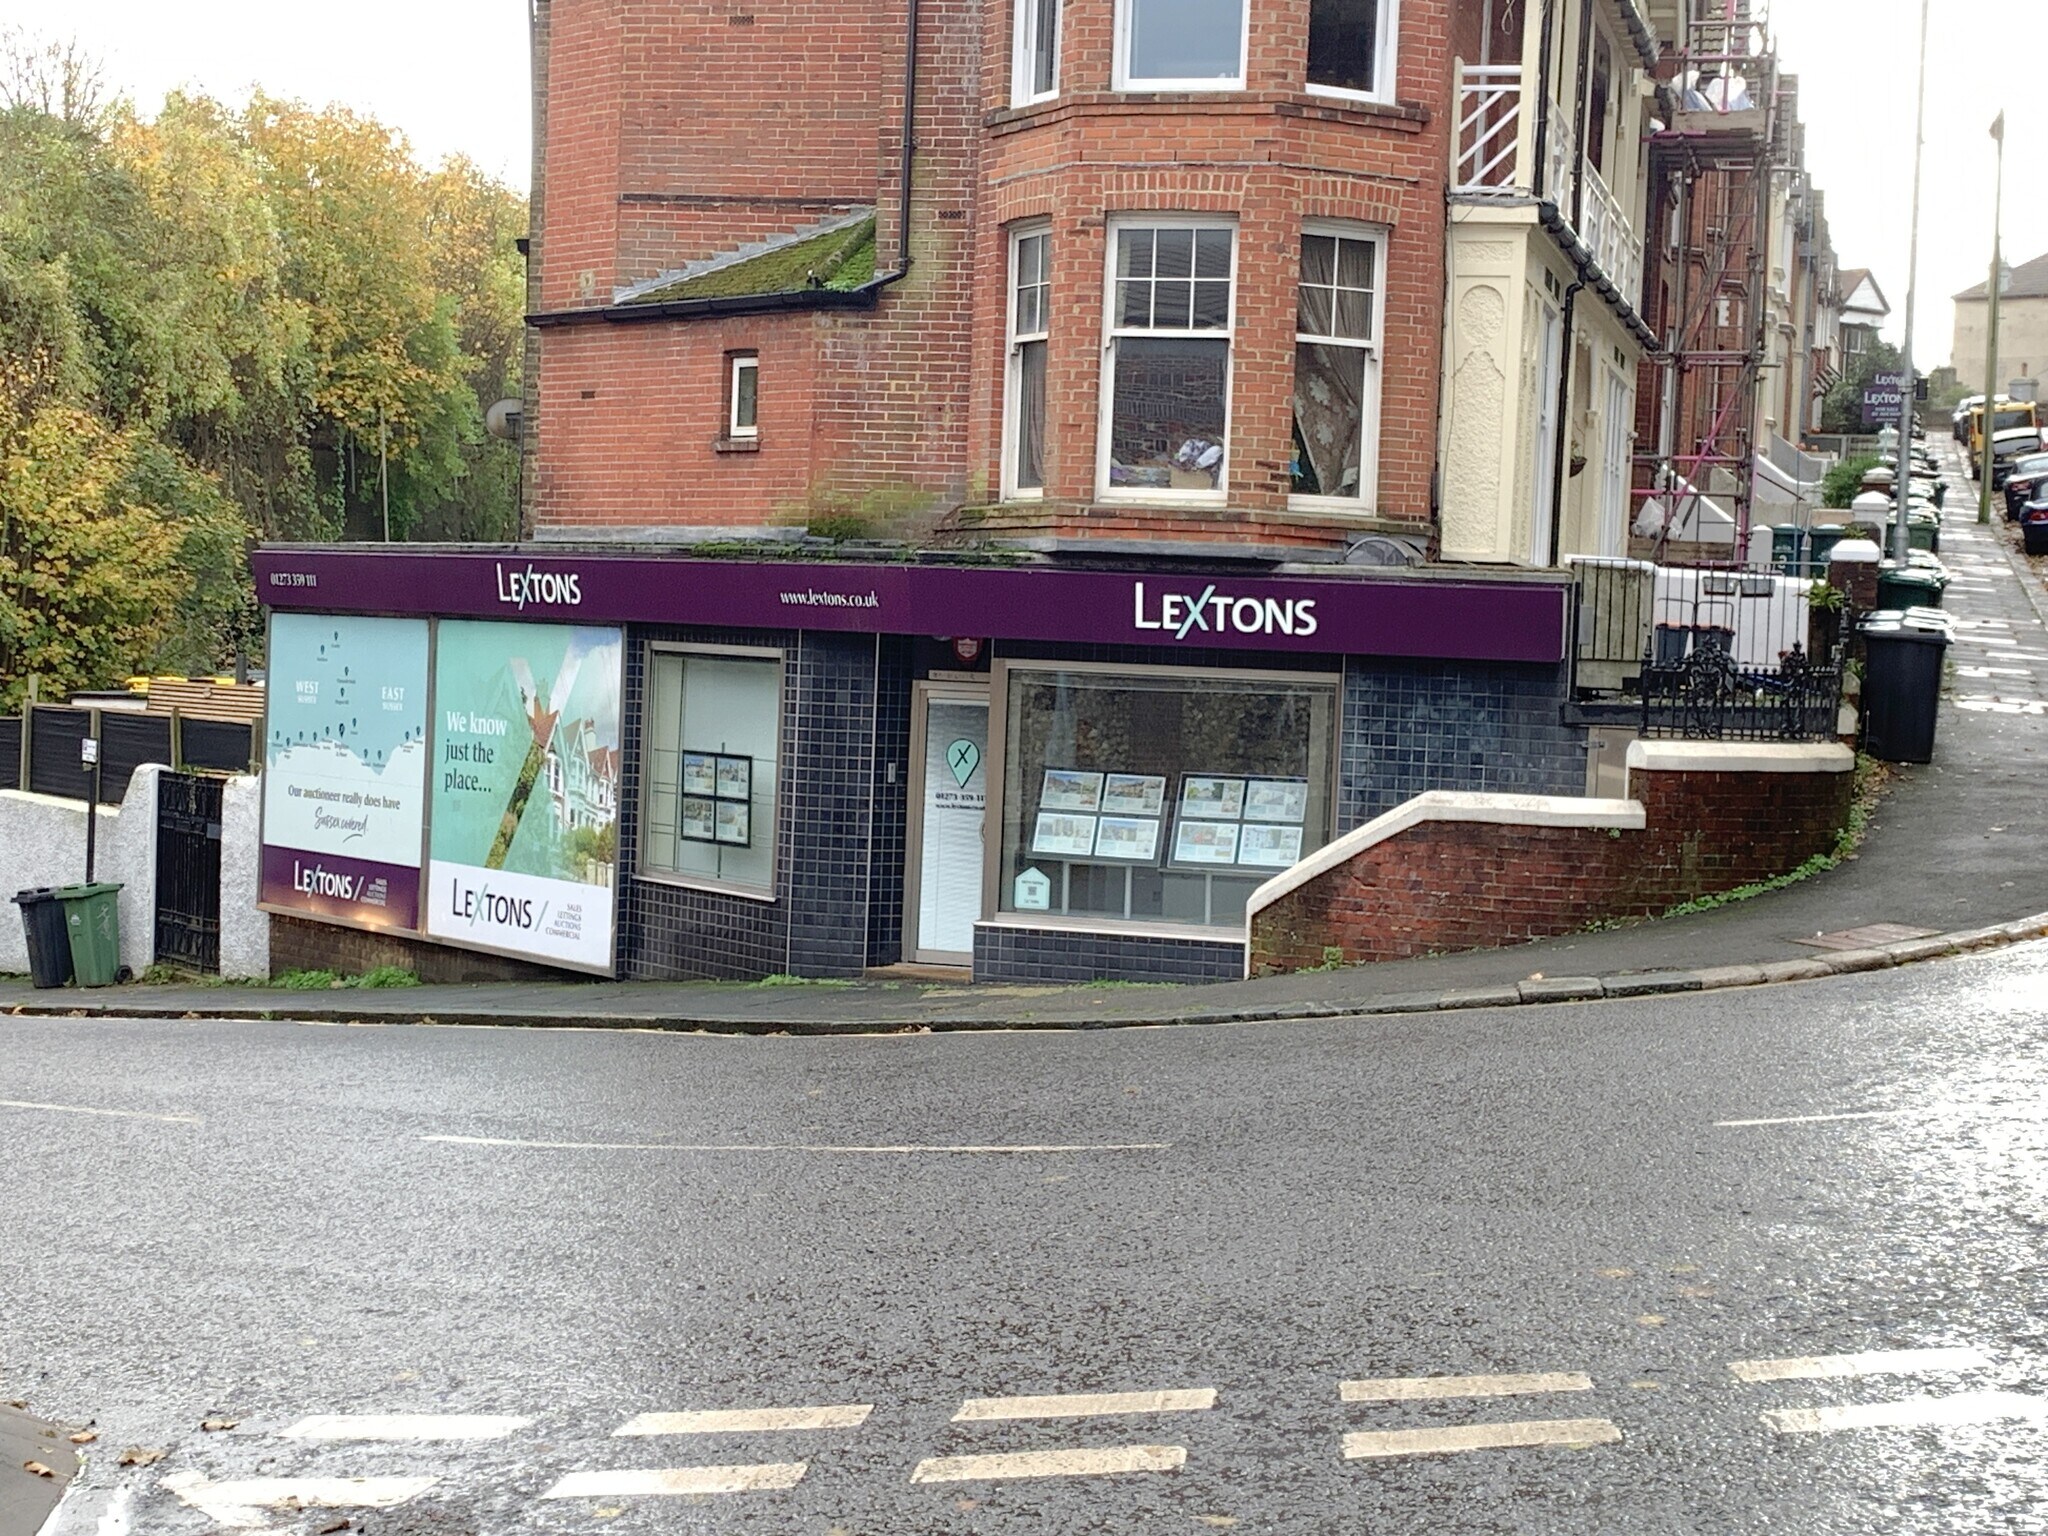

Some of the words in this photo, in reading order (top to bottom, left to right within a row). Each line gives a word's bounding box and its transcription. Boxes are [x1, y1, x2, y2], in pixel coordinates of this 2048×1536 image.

[1864, 391, 1903, 406] LEXTON
[270, 572, 292, 586] 01273
[292, 573, 306, 587] 359
[306, 574, 317, 587] 111
[496, 562, 582, 612] LEXTONS
[780, 588, 880, 608] www.lextons.co.uk
[1134, 582, 1318, 640] LEXTONS
[295, 680, 319, 695] WEST
[381, 686, 405, 701] EAST
[446, 711, 467, 733] We
[469, 711, 507, 737] know
[444, 738, 469, 765] just
[473, 741, 494, 764] the
[444, 767, 491, 793] place...
[288, 784, 302, 797] Our
[303, 787, 341, 802] auctioneer
[342, 792, 363, 808] really
[364, 793, 381, 808] does
[382, 796, 401, 810] have
[294, 860, 353, 900] LEXTONS
[452, 877, 533, 929] LEXTONS
